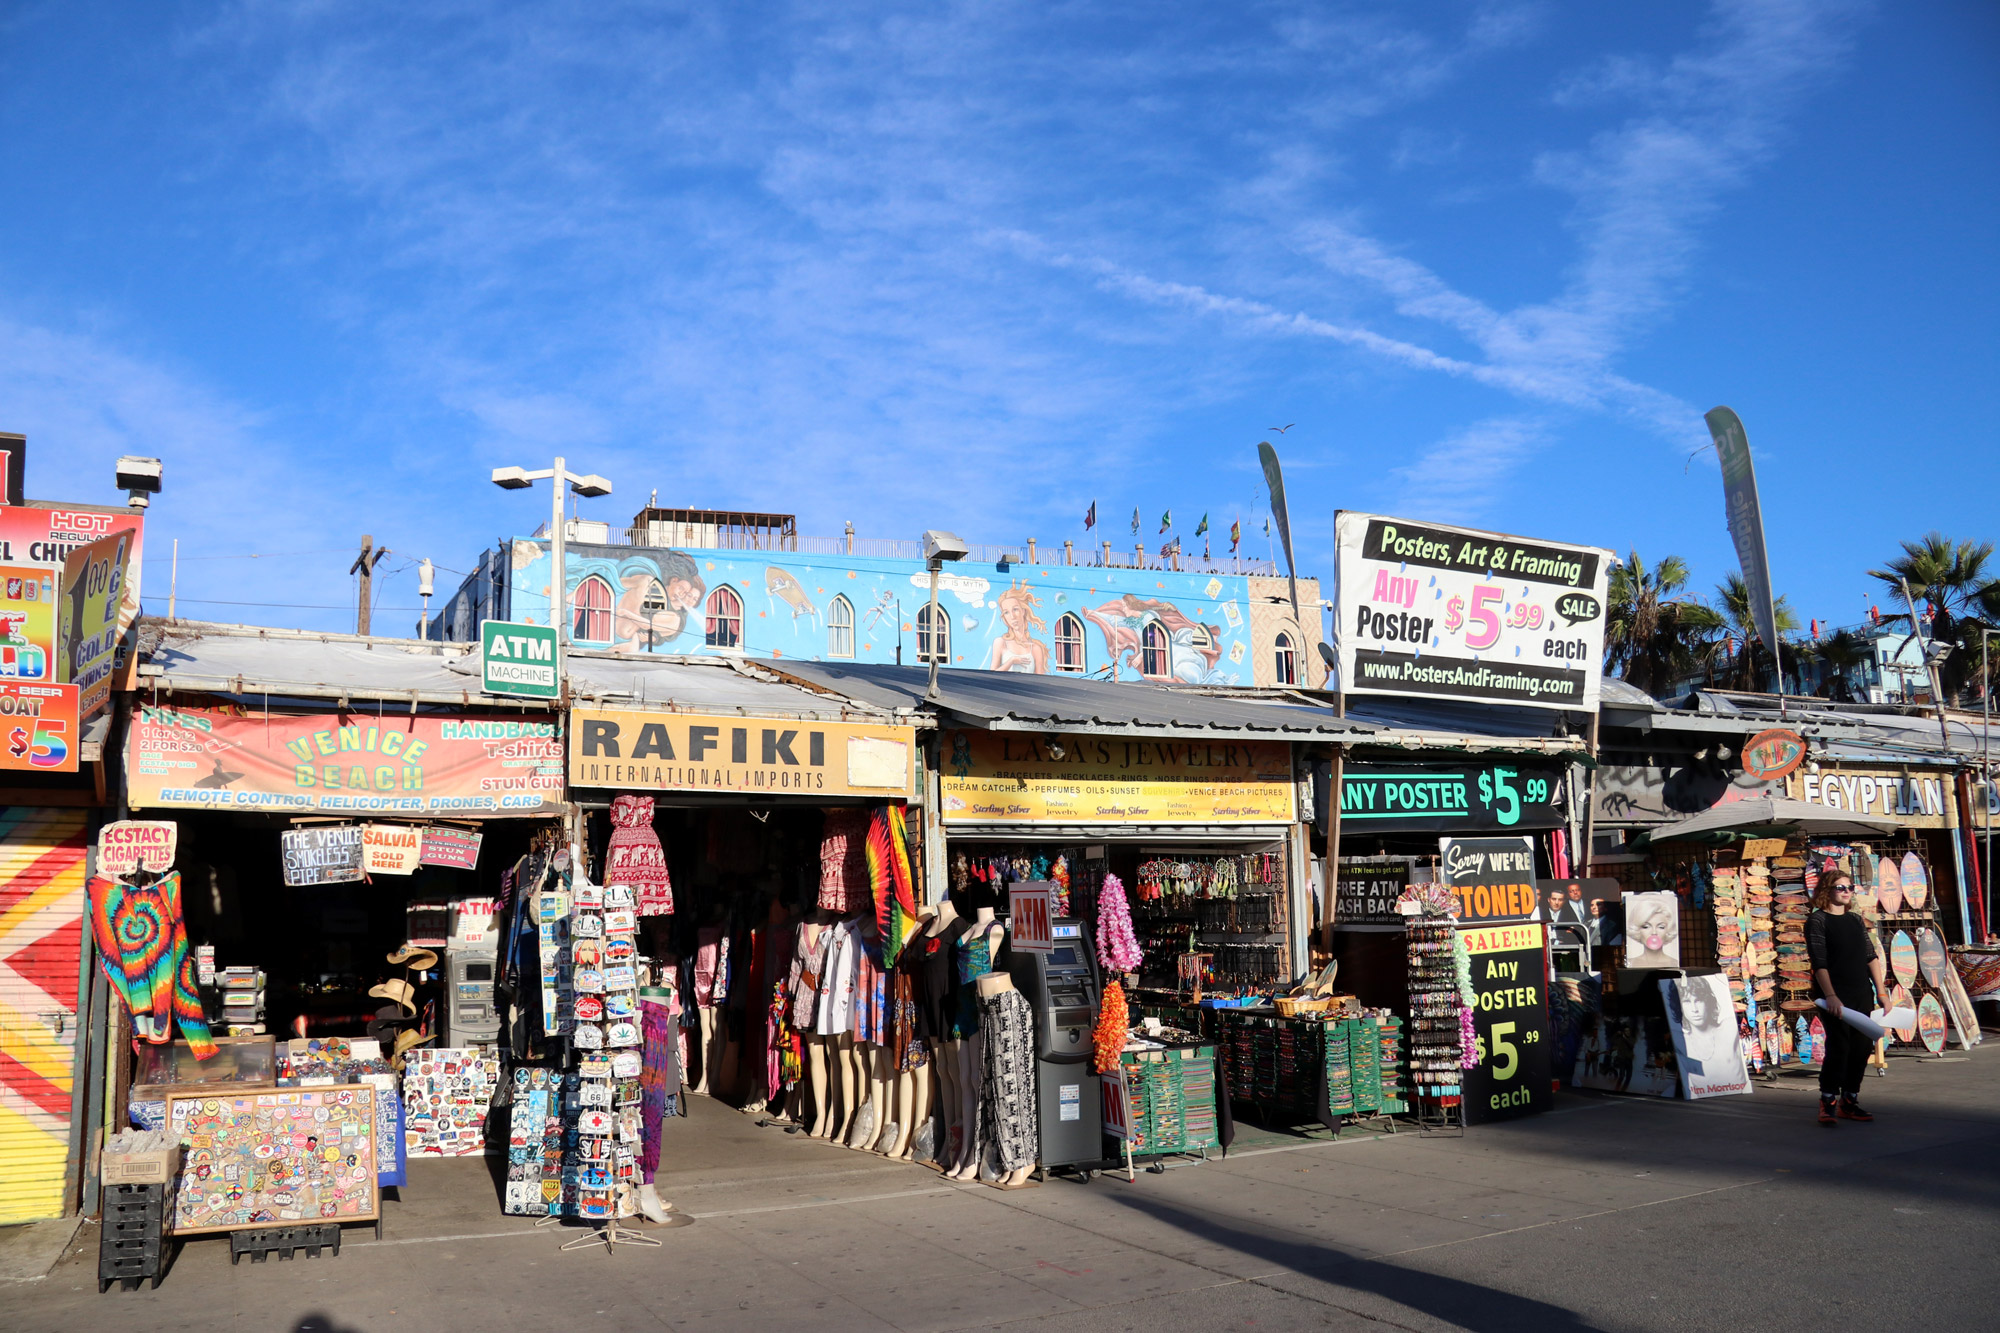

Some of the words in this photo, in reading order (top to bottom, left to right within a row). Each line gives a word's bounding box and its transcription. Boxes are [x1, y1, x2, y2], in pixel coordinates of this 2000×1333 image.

[51, 511, 113, 532] HOT
[50, 531, 111, 542] REGULA
[1380, 525, 1453, 566] Posters,
[1457, 542, 1488, 567] Art
[1490, 547, 1506, 570] &
[1510, 550, 1582, 586] Framing
[1372, 568, 1419, 608] Any
[1561, 598, 1596, 618] SALE
[1356, 604, 1433, 645] Poster
[1542, 637, 1587, 661] each
[489, 634, 551, 661] ATM
[491, 666, 550, 682] MACHINE
[1364, 662, 1574, 697] www.PostersAndFraming.com
[142, 708, 211, 732] PIPES
[441, 721, 564, 739] HANDBAGS
[142, 728, 149, 738] 1
[152, 727, 170, 739] for
[172, 730, 195, 741] $12
[581, 719, 825, 767] RAFIKI
[140, 741, 148, 750] 2
[153, 741, 177, 750] FOR
[182, 742, 203, 752] $20
[286, 725, 429, 765] VENICE
[484, 741, 564, 759] T-shirts
[1119, 742, 1257, 769] JEWELRY
[295, 764, 423, 790] BEACH
[481, 778, 526, 791] STUN
[530, 776, 564, 790] GUN
[581, 763, 733, 786] INTERNATIONAL
[745, 771, 823, 789] IMPORTS
[997, 771, 1052, 779] BRACELETS
[1061, 773, 1114, 781] NECKLACES
[160, 789, 232, 803] REMOTE
[237, 792, 316, 807] CONTROL
[320, 794, 425, 811] HELICOPTER,
[430, 796, 498, 811] DRONES,
[501, 795, 542, 807] CARS
[947, 783, 978, 791] DREAM
[982, 784, 1028, 793] CATCHERS
[1035, 786, 1080, 794] PERFUMES
[1110, 787, 1140, 795] SUNSET
[1189, 788, 1217, 796] VENICE
[1384, 782, 1468, 809] POSTER
[105, 828, 171, 844] ECSTACY
[284, 832, 311, 850] THE
[316, 829, 361, 848] VENICE
[363, 830, 417, 848] SALVIA
[423, 829, 481, 843] PIPES
[286, 847, 350, 869] SMOKELESS
[372, 851, 404, 861] SOLD
[427, 853, 466, 863] GUNS
[428, 845, 465, 855] STUN
[1446, 844, 1486, 876] Sorry
[1489, 852, 1531, 872] WE'RE
[372, 860, 403, 869] HERE
[289, 868, 320, 886] PIPE
[1370, 881, 1399, 896] ATM
[456, 902, 496, 915] ATM
[1014, 898, 1049, 941] ATM
[1464, 929, 1532, 952] SALE!!!
[1486, 959, 1518, 981] Any
[1490, 1085, 1531, 1110] each
